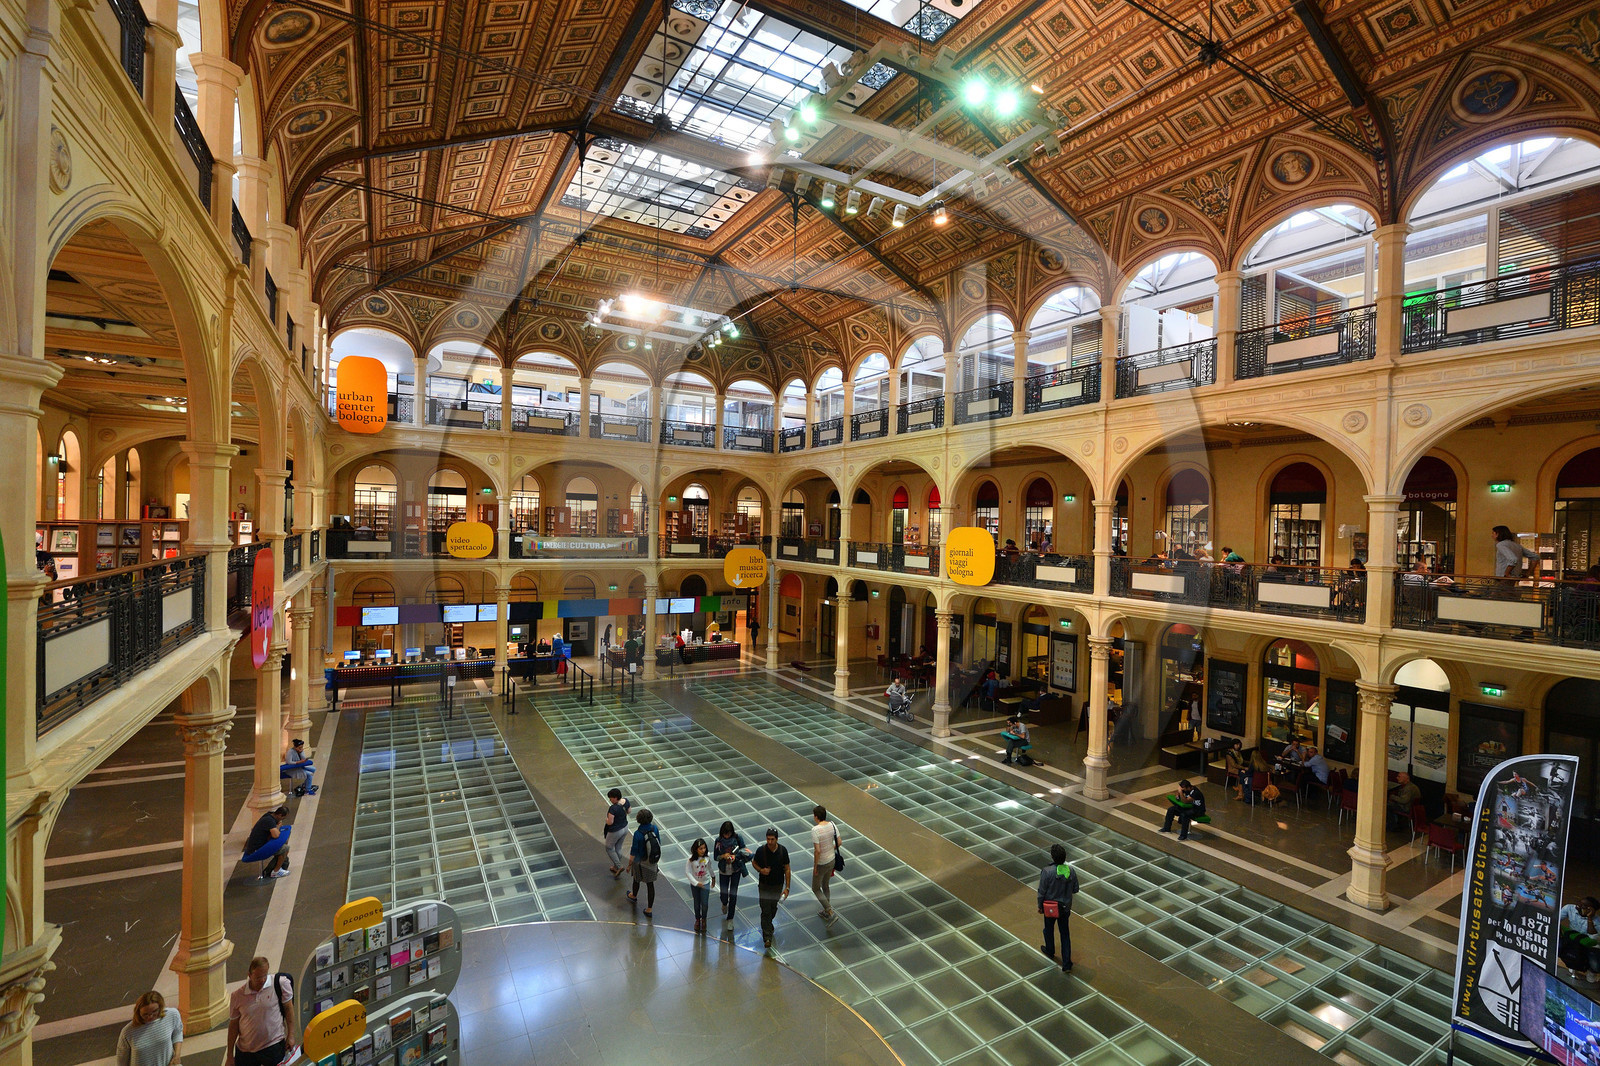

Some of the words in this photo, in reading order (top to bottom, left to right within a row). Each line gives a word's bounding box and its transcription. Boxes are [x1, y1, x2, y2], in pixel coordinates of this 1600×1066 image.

[339, 391, 373, 402] urban
[338, 403, 375, 412] center
[338, 410, 384, 424] bologna
[450, 544, 487, 552] spettacolo
[949, 547, 974, 558] giornali
[1571, 539, 1579, 571] bologna
[949, 557, 968, 568] viaggi
[949, 566, 974, 578] bologna
[343, 907, 384, 926] proposte
[1461, 808, 1491, 1016] www.virtusatletica.it
[1536, 912, 1551, 924] Dal
[1520, 916, 1550, 935] 1871
[1515, 936, 1548, 959] Sport
[323, 1011, 367, 1038] novità
